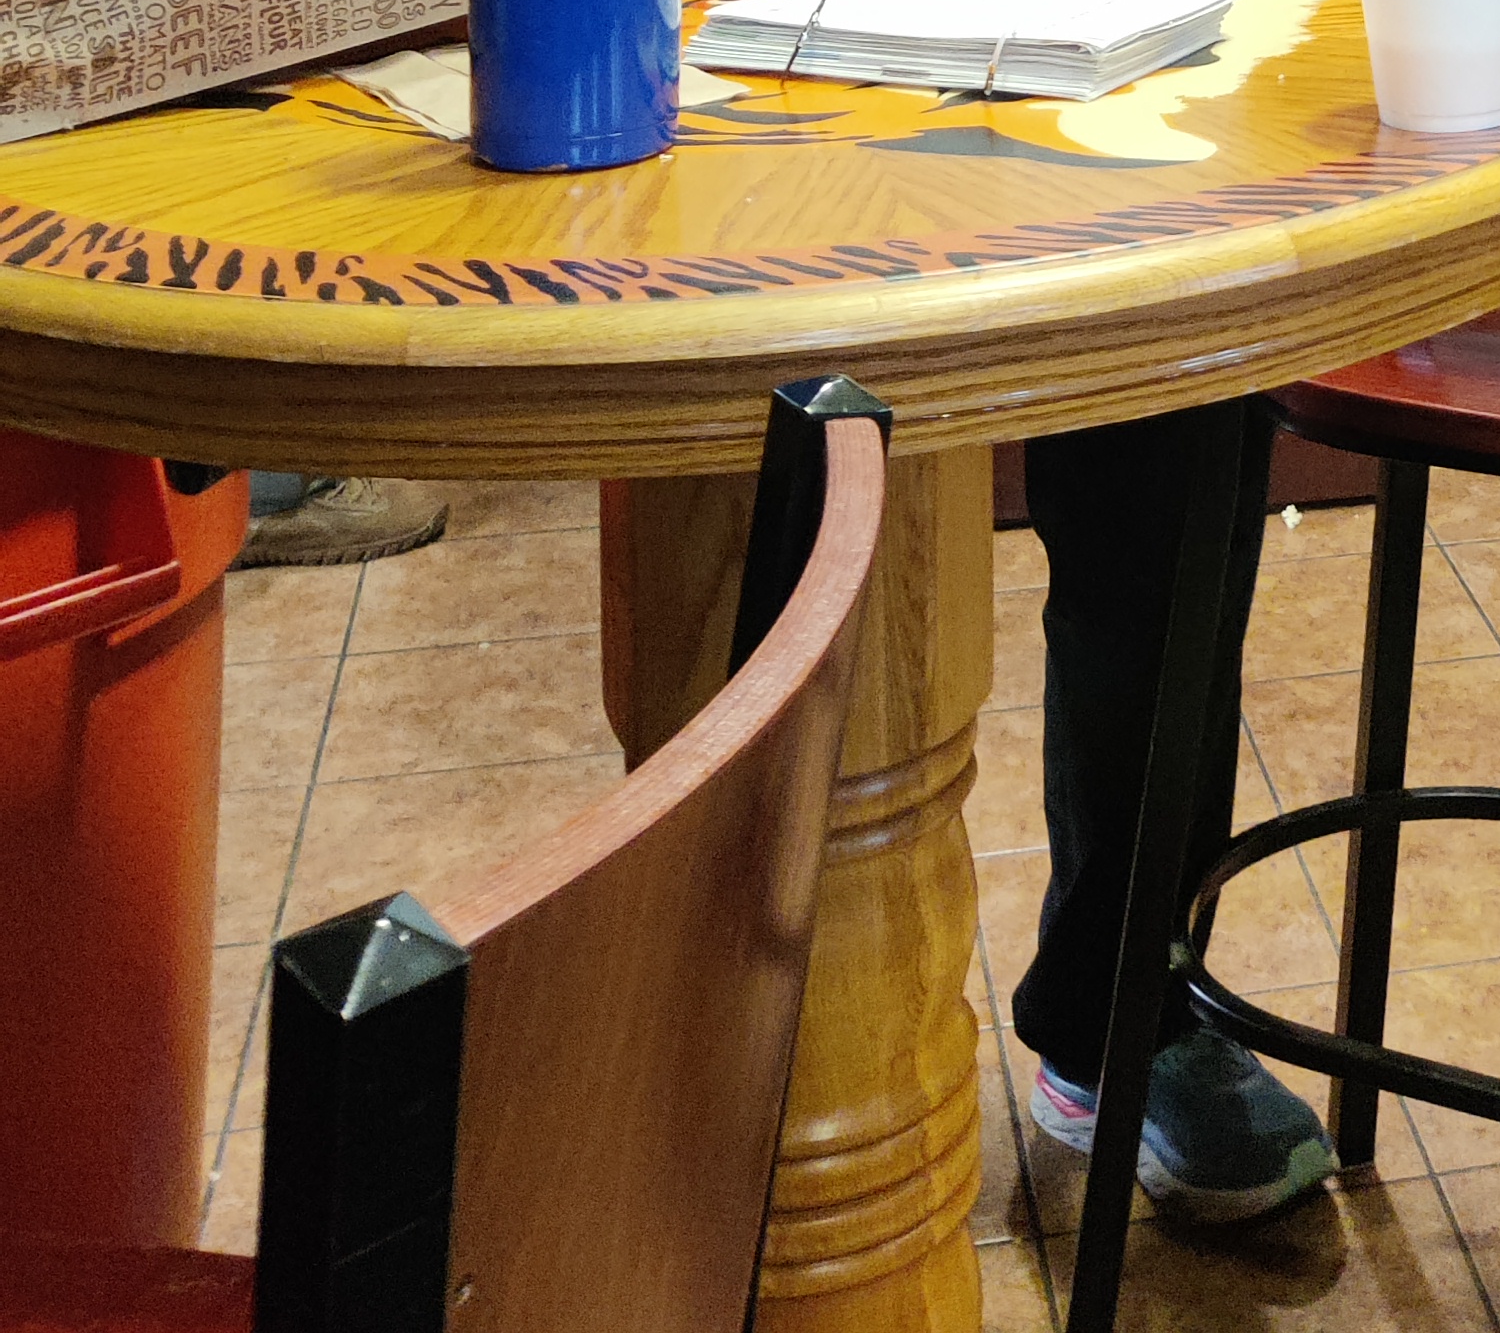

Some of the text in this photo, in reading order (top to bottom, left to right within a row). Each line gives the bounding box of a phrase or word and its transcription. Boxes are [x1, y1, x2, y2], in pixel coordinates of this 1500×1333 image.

[61, 33, 85, 60] SOY
[87, 34, 120, 106] SALT
[116, 25, 136, 101] THYME
